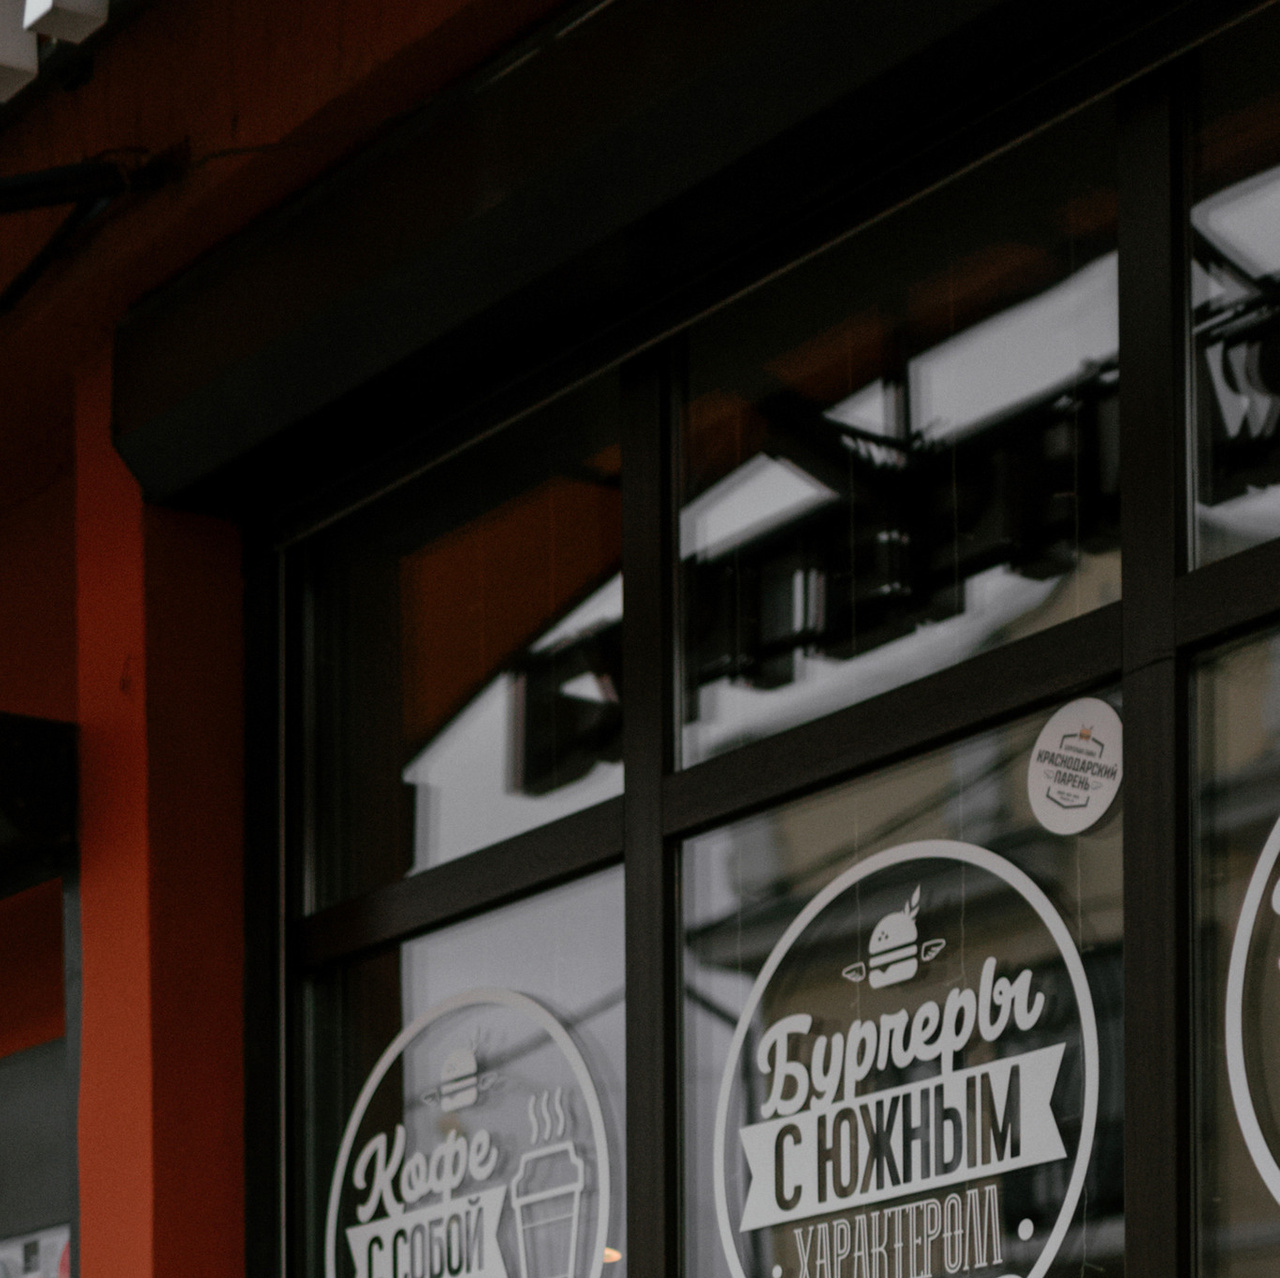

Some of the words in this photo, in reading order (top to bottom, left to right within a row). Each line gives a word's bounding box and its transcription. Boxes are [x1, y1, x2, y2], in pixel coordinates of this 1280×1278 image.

[1036, 749, 1118, 781] КРАСНОДАРСКИЙ
[1054, 770, 1091, 791] ПАРЕНЬ
[757, 956, 1046, 1119] Бургеры
[351, 1123, 499, 1224] Кофе
[774, 1123, 803, 1212] С
[816, 1063, 1022, 1204] ЮЖНЫМ
